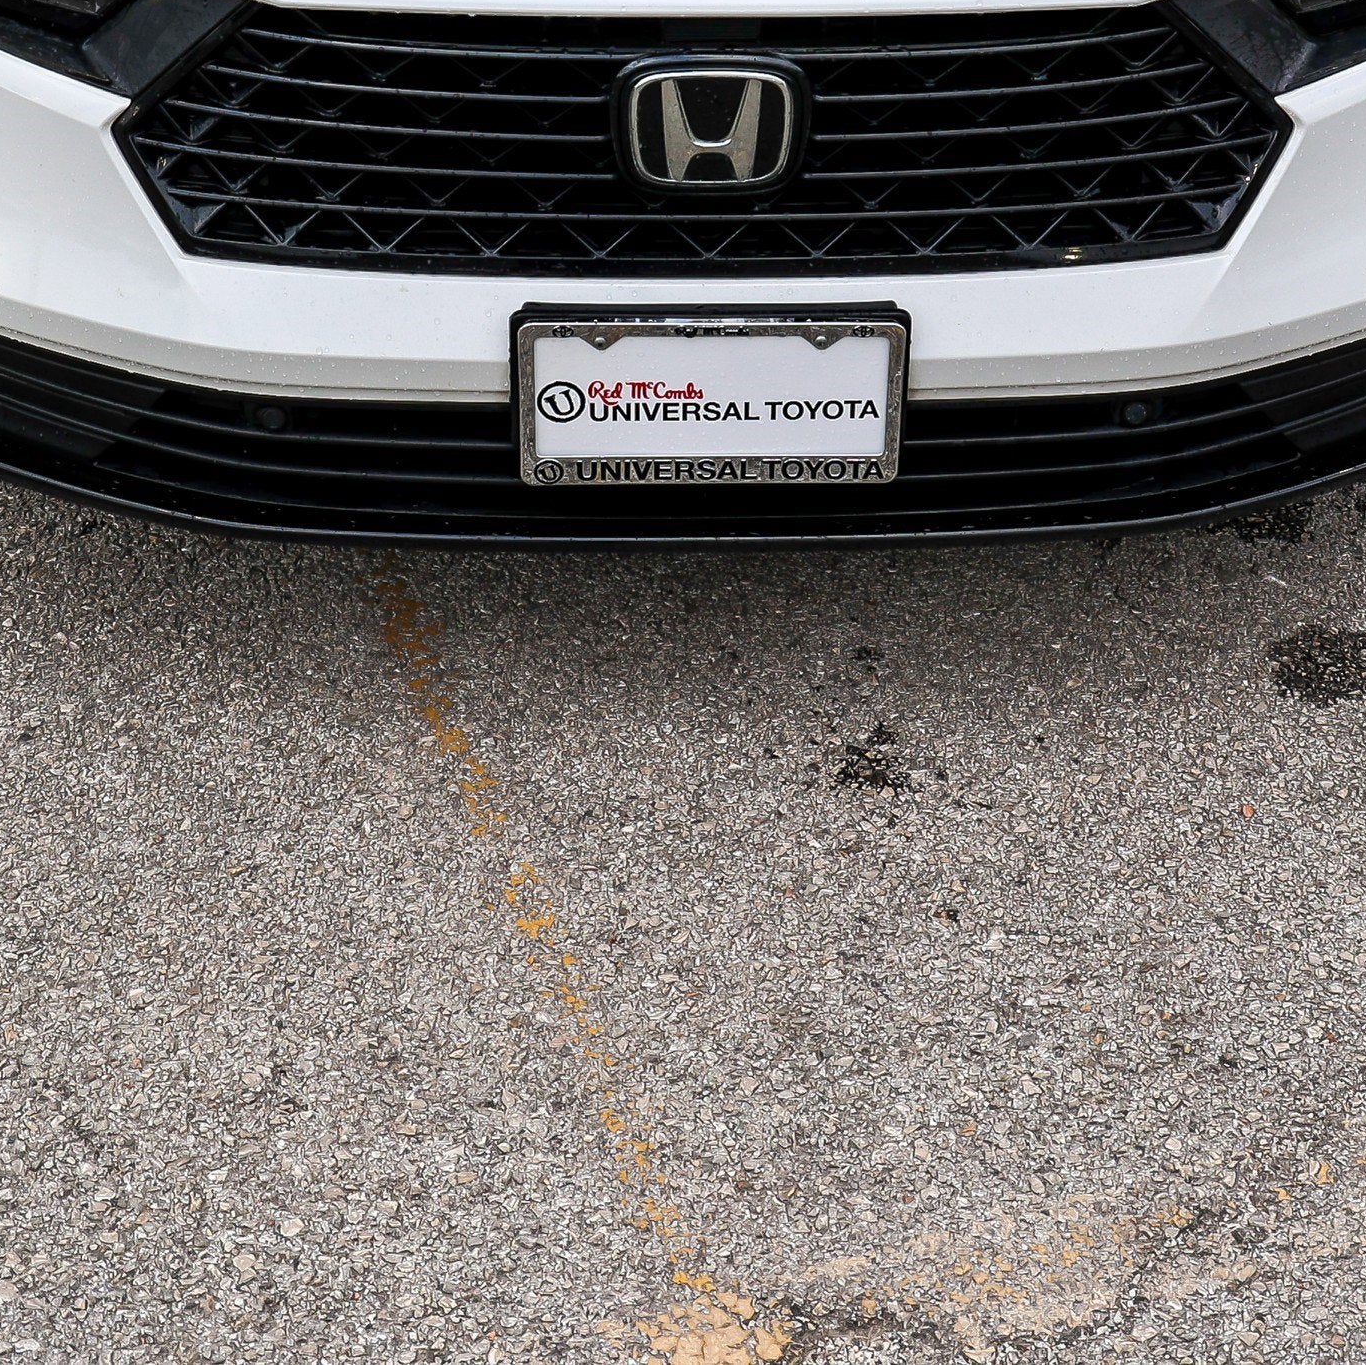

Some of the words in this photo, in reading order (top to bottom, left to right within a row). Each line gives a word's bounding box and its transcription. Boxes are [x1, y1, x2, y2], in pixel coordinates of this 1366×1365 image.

[588, 381, 623, 406] Red
[625, 381, 704, 400] McCombs
[589, 401, 760, 422] UNIVERSAL
[764, 399, 880, 421] TOYOTA
[576, 458, 758, 482] UNIVERSAL
[762, 458, 885, 481] TOYOTA
